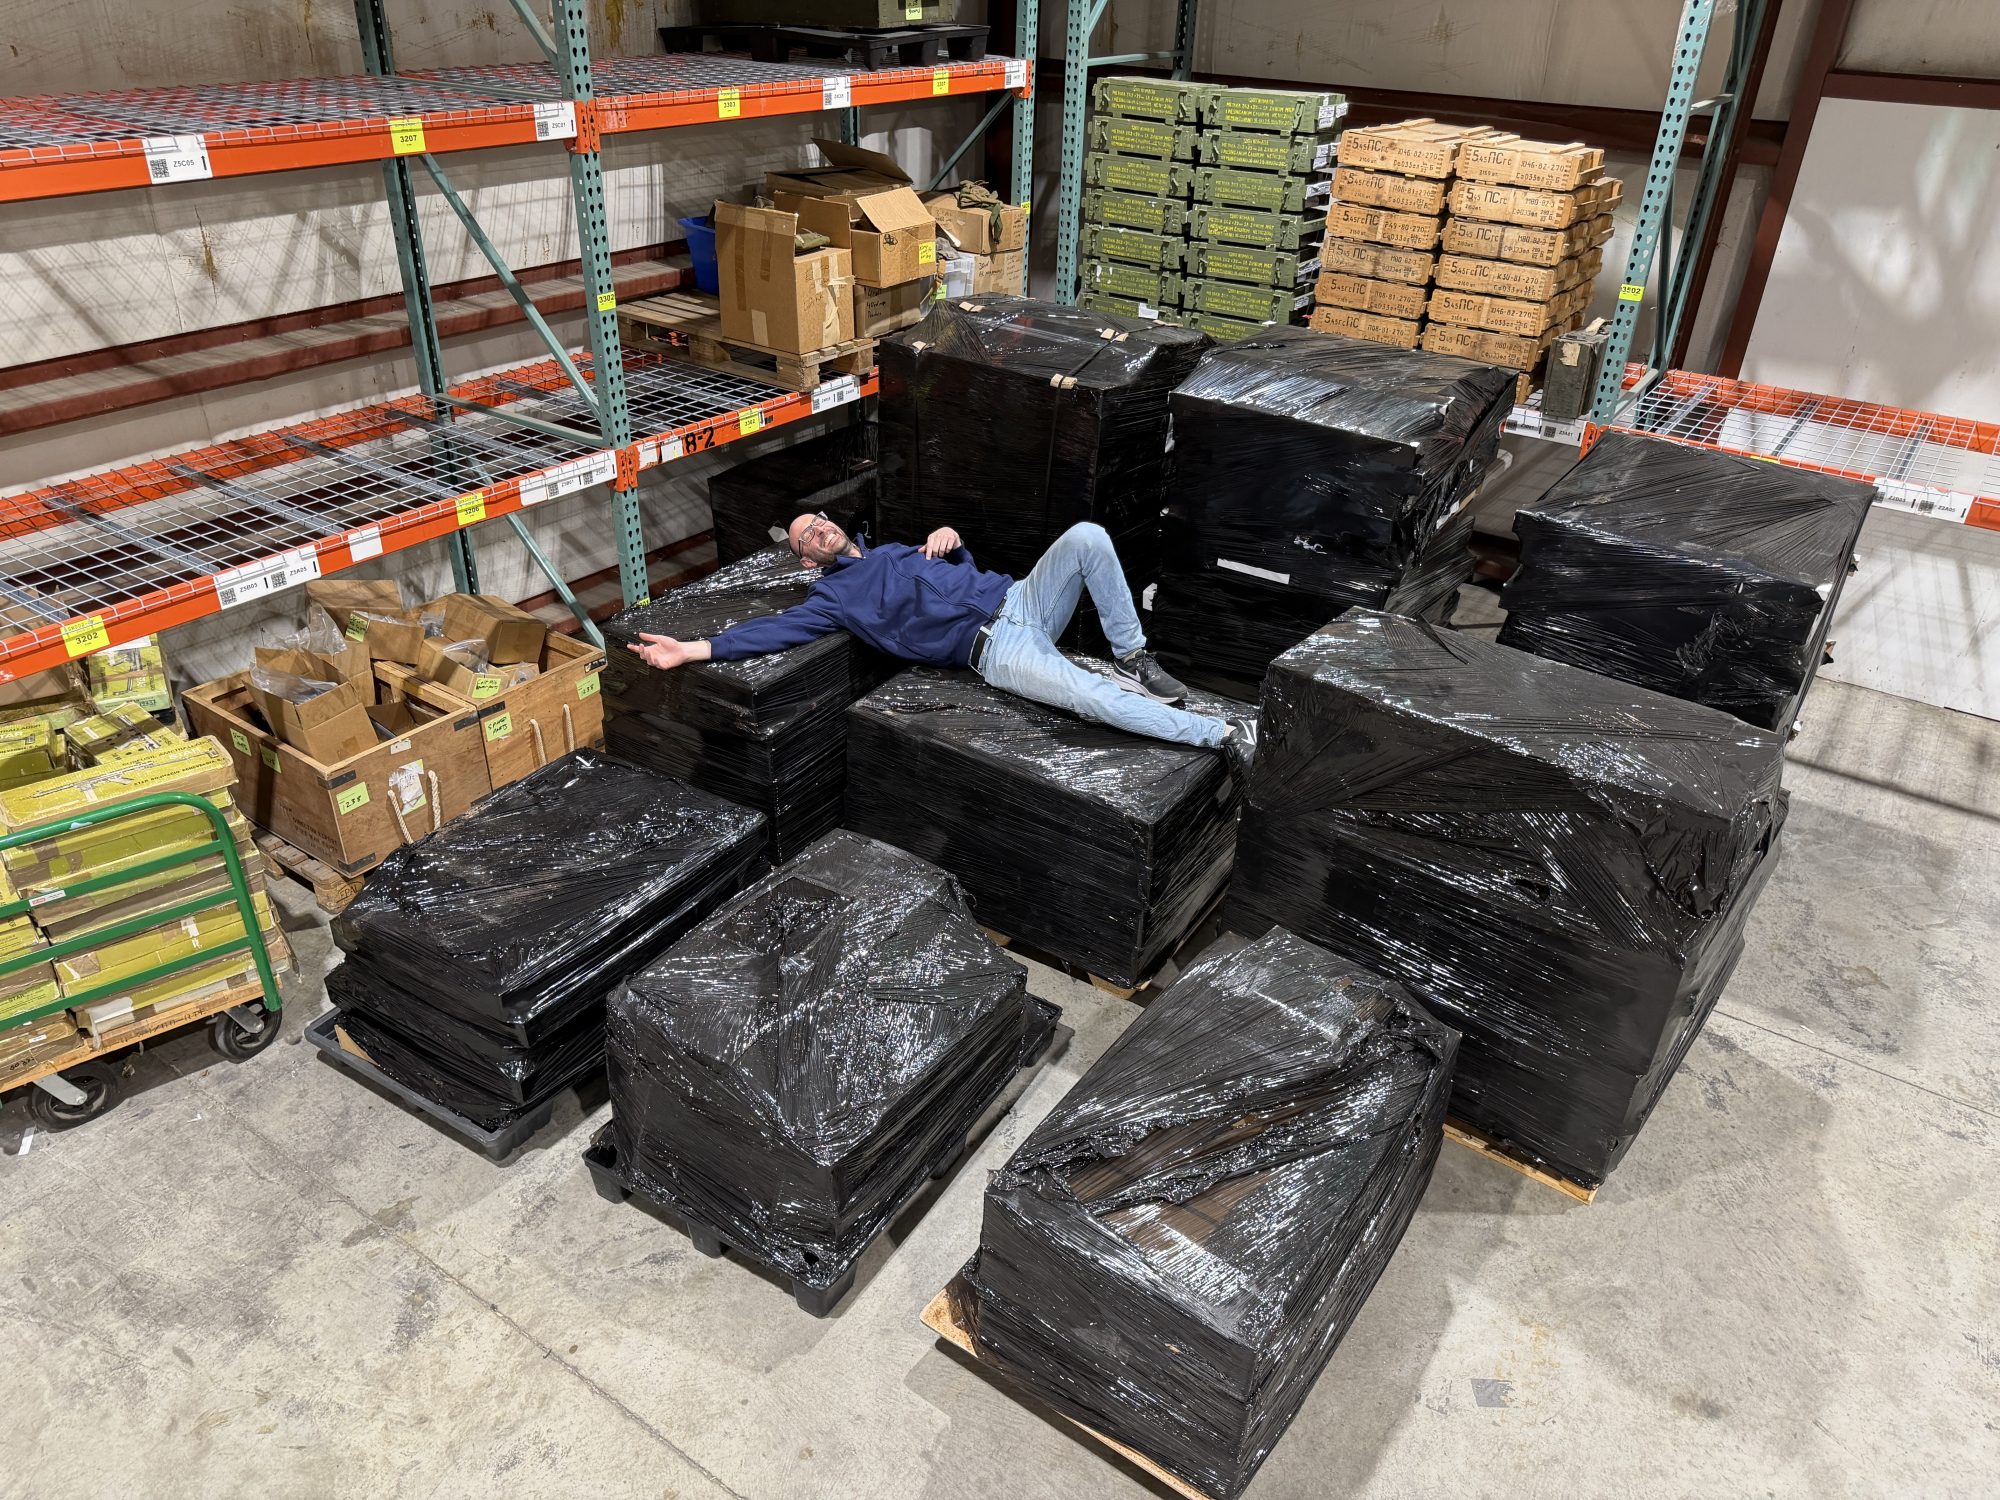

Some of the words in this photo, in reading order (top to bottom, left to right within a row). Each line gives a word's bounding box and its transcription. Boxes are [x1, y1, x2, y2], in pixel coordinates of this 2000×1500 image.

[400, 134, 417, 143] 3207
[1622, 286, 1641, 295] 3502
[599, 293, 615, 303] 3302
[464, 506, 479, 515] 3206
[75, 631, 99, 645] 3202
